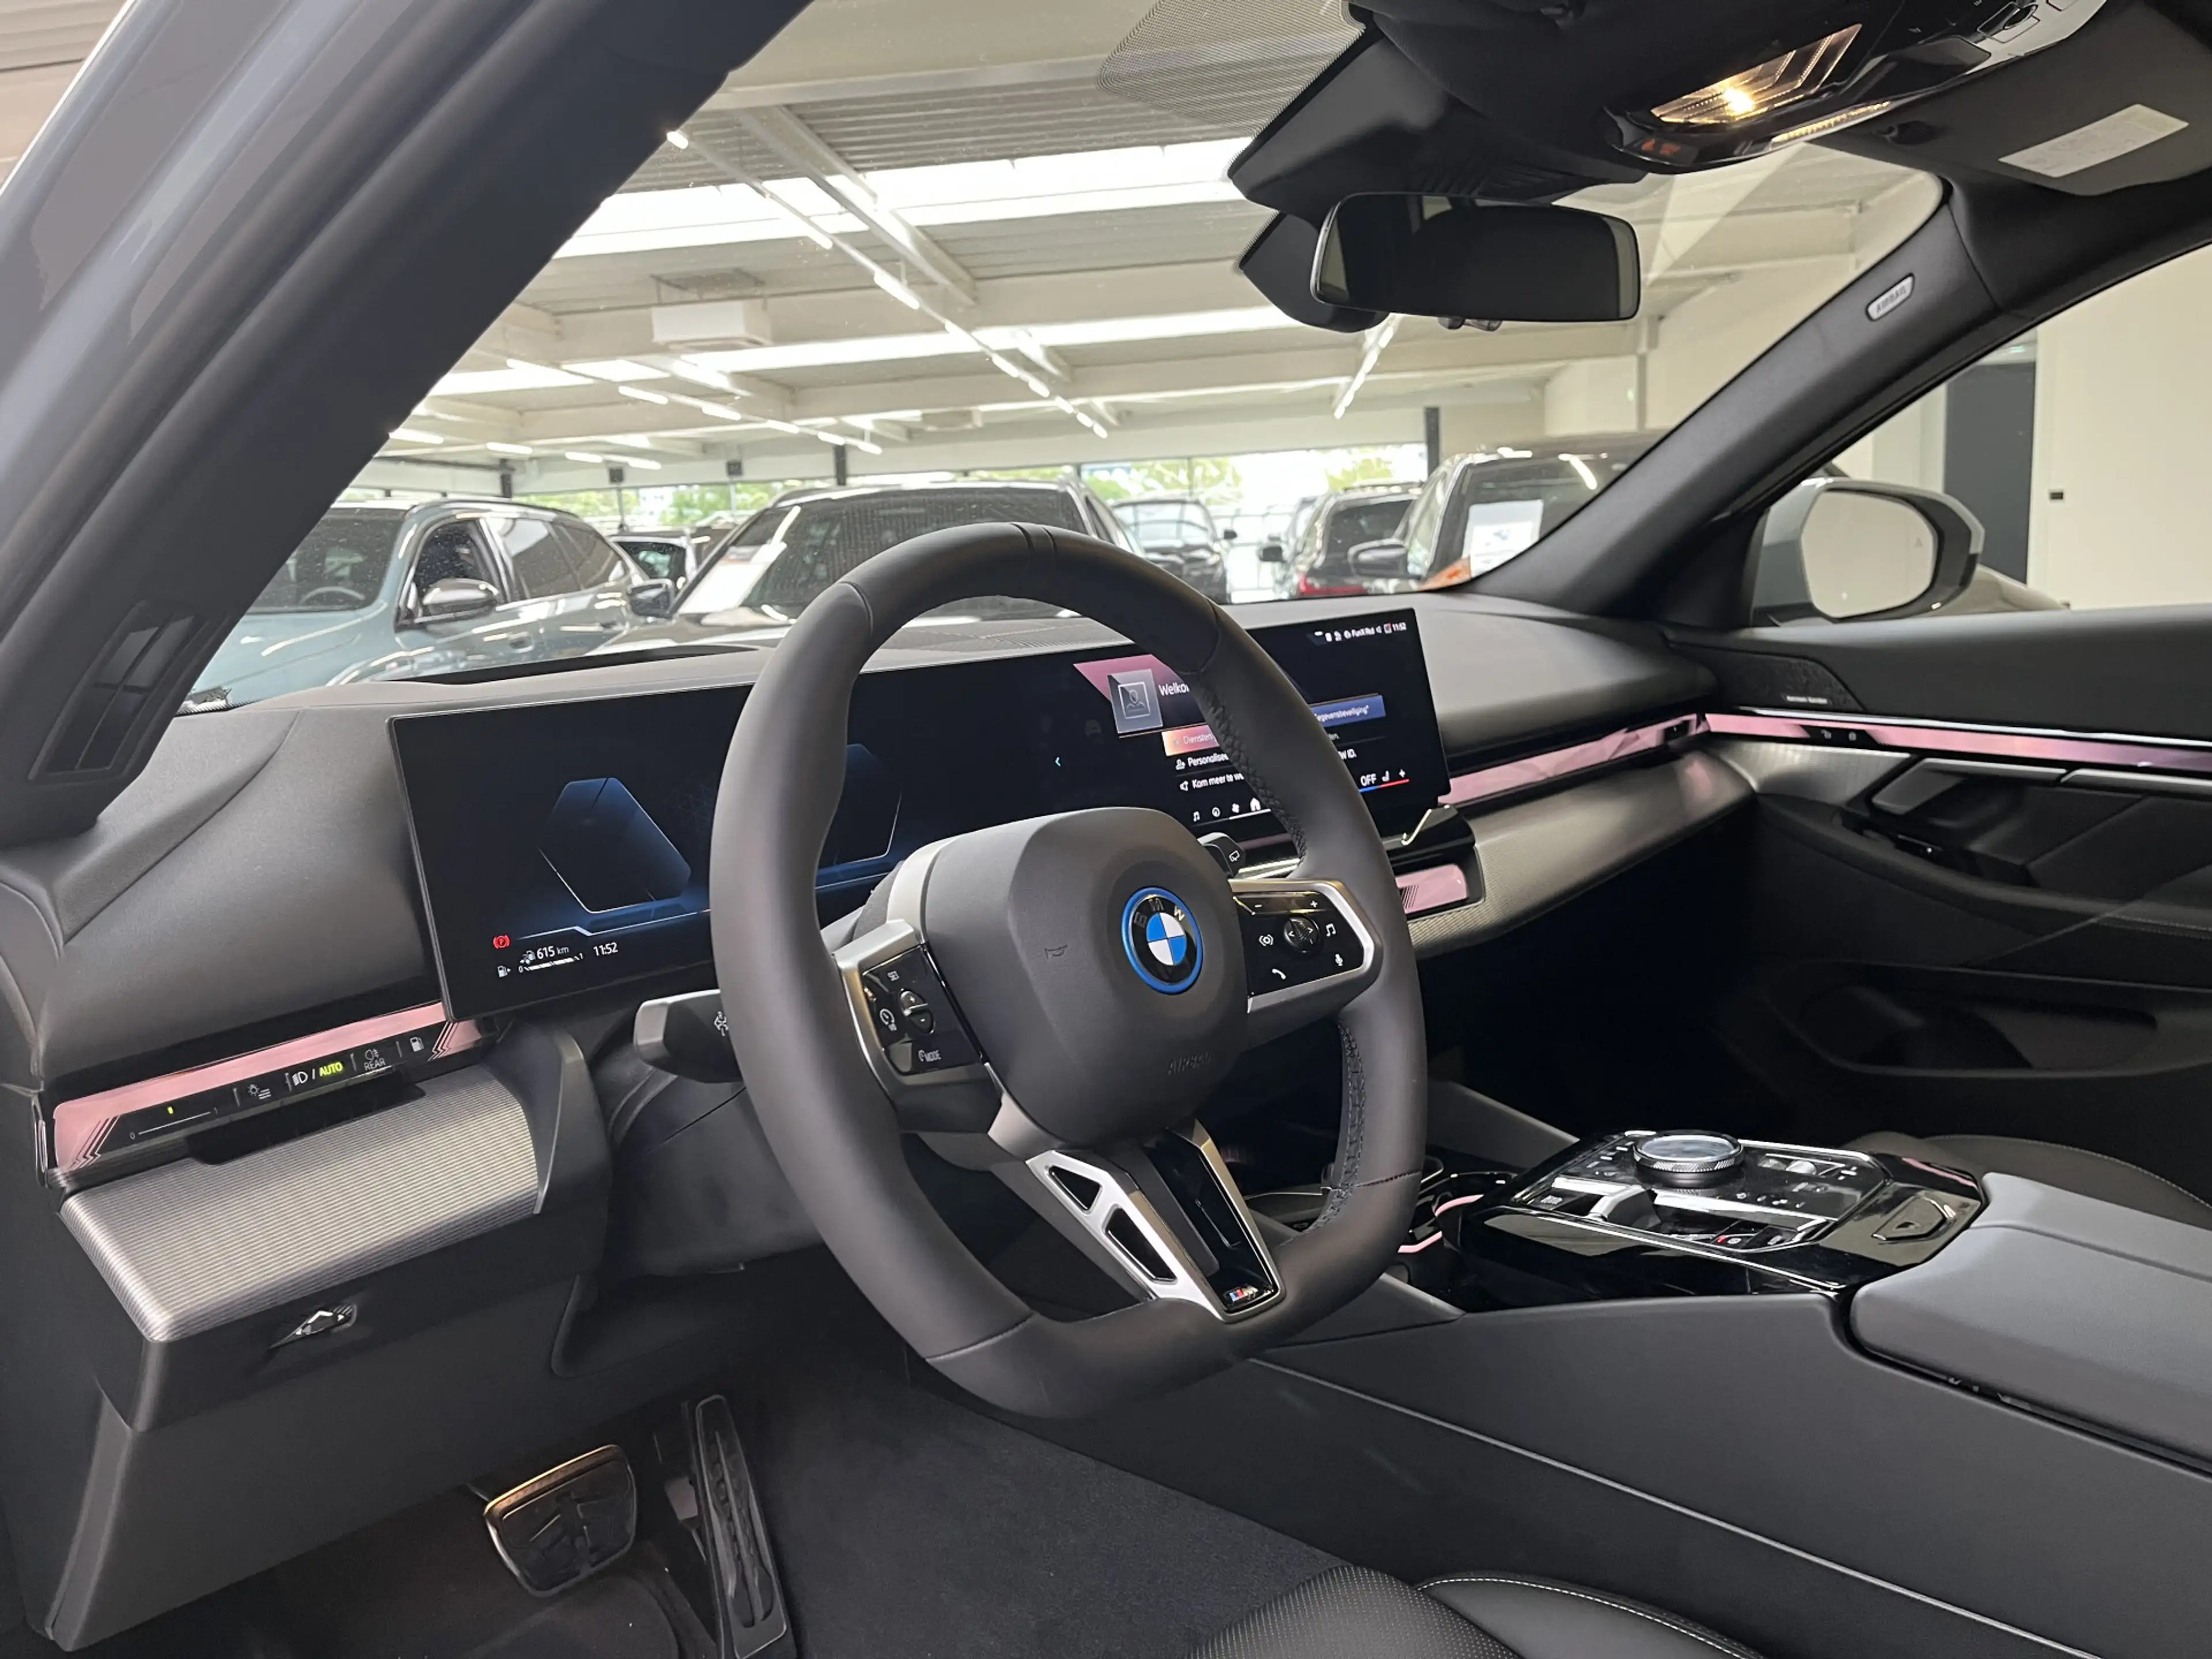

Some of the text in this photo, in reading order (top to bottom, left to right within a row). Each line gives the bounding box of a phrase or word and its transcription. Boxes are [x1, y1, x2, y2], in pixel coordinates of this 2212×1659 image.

[1360, 773, 1377, 787] OFF
[536, 945, 570, 960] 615 km
[593, 941, 619, 957] 11:52
[319, 1061, 344, 1077] AUTO
[363, 1058, 386, 1071] REAR
